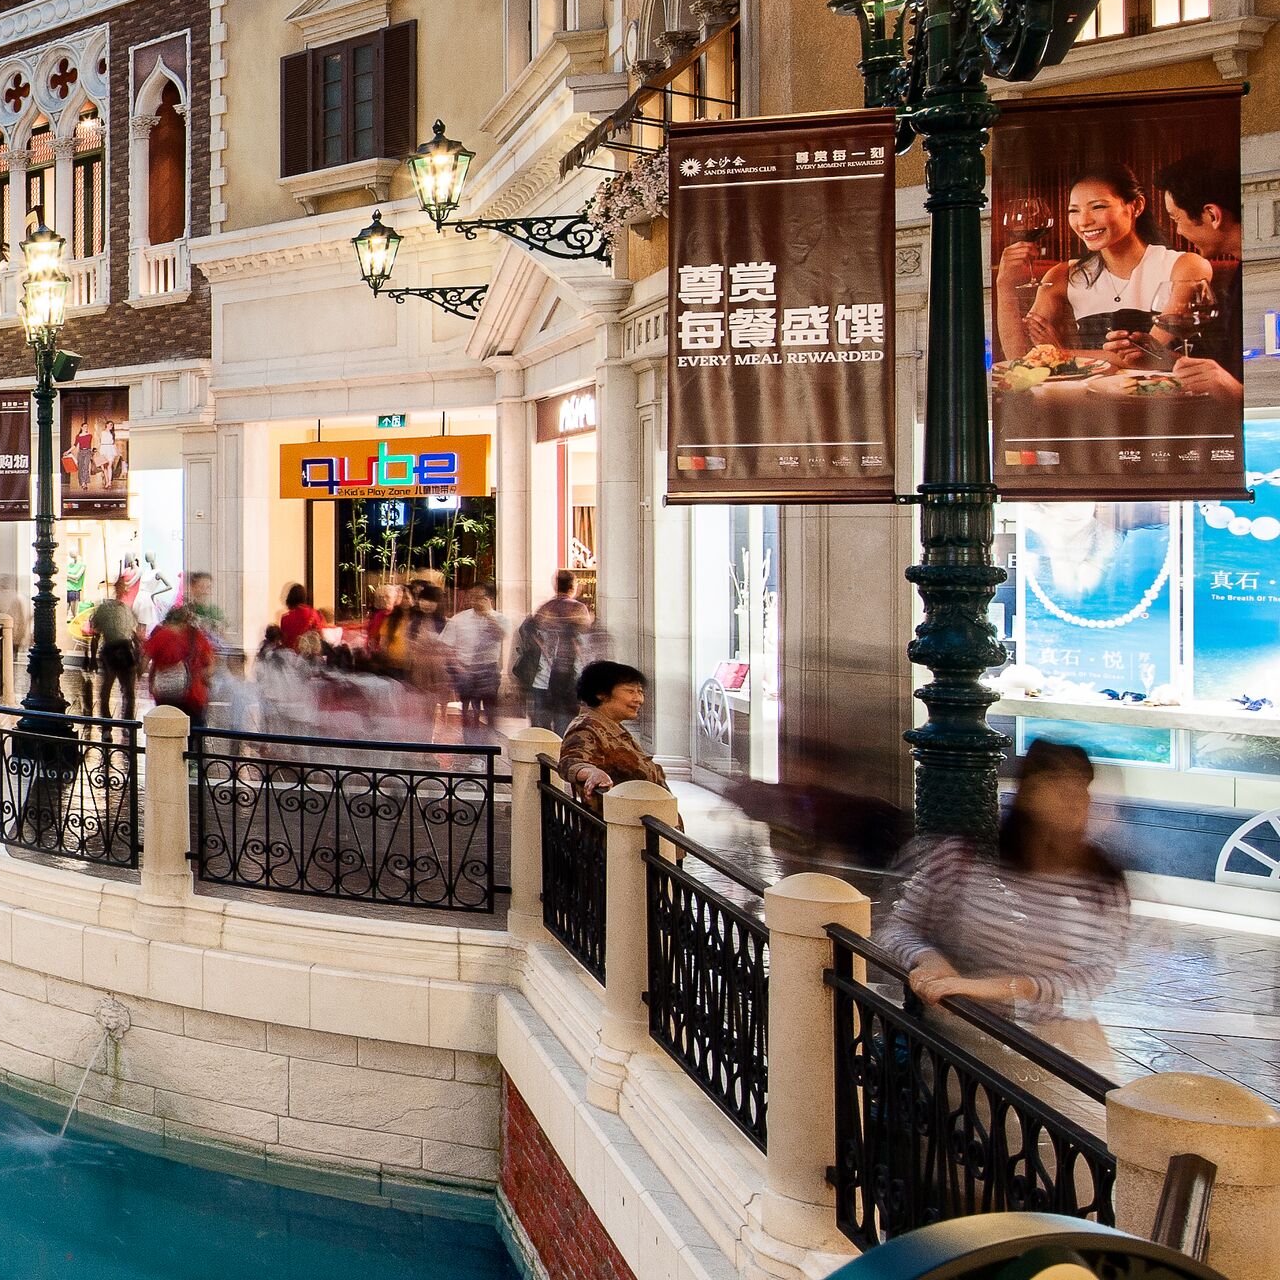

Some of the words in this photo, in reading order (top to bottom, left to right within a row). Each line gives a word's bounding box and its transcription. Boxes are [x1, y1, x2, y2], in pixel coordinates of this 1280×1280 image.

[704, 156, 746, 169] 金沙会
[726, 167, 758, 175] REWARDS
[759, 165, 777, 173] CLUB
[817, 161, 847, 169] MOMENT
[847, 159, 884, 167] REWARDED
[678, 261, 777, 305] 尊赏
[678, 303, 884, 350] 每餐盛馔
[678, 354, 731, 367] EVERY
[734, 352, 782, 366] MEAL
[787, 350, 884, 364] REWARDED
[302, 442, 458, 495] qube
[344, 487, 366, 496] Kid's
[367, 488, 386, 497] Play
[388, 487, 411, 496] Zone
